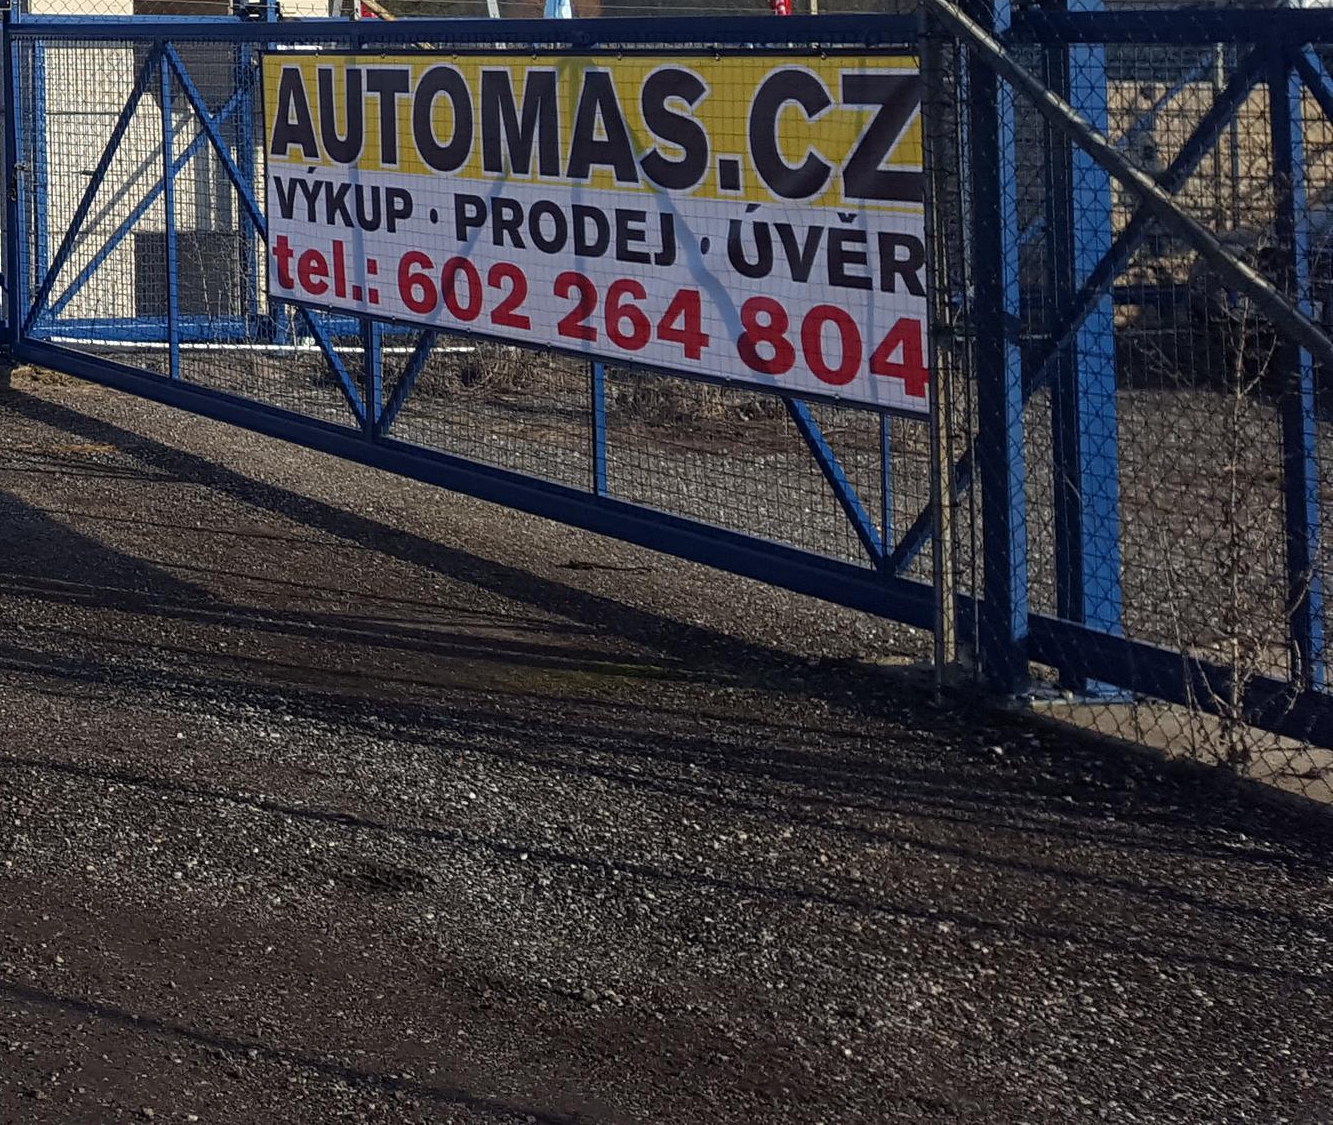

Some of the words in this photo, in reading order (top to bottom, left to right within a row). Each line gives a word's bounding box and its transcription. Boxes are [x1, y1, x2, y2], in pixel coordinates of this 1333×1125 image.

[270, 67, 925, 204] AUTOMAS.CZ
[273, 166, 414, 235] VÝKUP
[454, 192, 679, 267] PRODEJ
[727, 203, 927, 298] ÚVĚR
[272, 235, 380, 304] tel.:
[398, 250, 532, 330] 602
[553, 271, 711, 361] 264
[736, 296, 931, 398] 804
